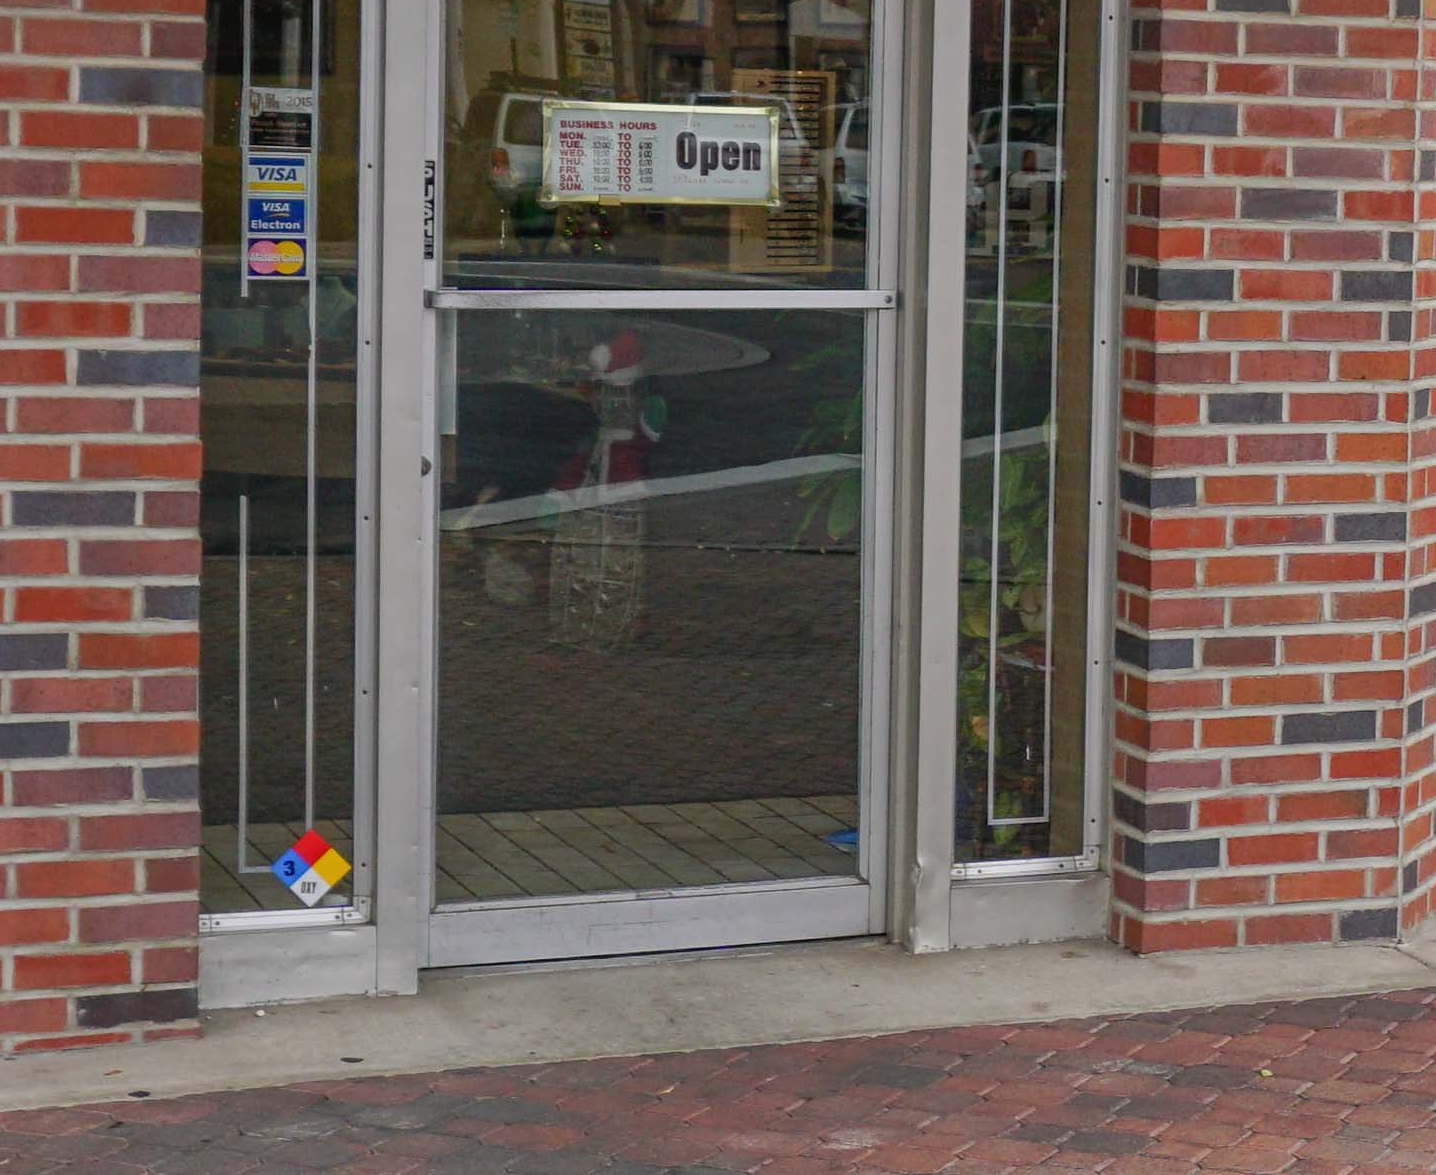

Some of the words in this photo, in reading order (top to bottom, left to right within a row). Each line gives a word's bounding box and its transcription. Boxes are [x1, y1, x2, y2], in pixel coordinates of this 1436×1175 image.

[559, 120, 614, 130] BUSINESS
[619, 121, 658, 131] HOURS
[559, 131, 587, 141] MON.
[617, 133, 632, 141] TO
[559, 140, 584, 149] TUE.
[617, 141, 632, 149] TO
[559, 149, 587, 158] WED.
[617, 150, 632, 158] TO
[676, 131, 761, 177] Open
[559, 158, 584, 167] THU.
[617, 159, 632, 167] TO
[257, 167, 298, 181] VISA
[617, 167, 632, 175] TO
[559, 175, 583, 184] SAT.
[617, 176, 632, 184] TO
[559, 183, 584, 191] SUN.
[262, 202, 290, 213] VISA
[251, 220, 301, 230] Electron
[283, 860, 296, 876] 3
[300, 881, 317, 894] OXY
